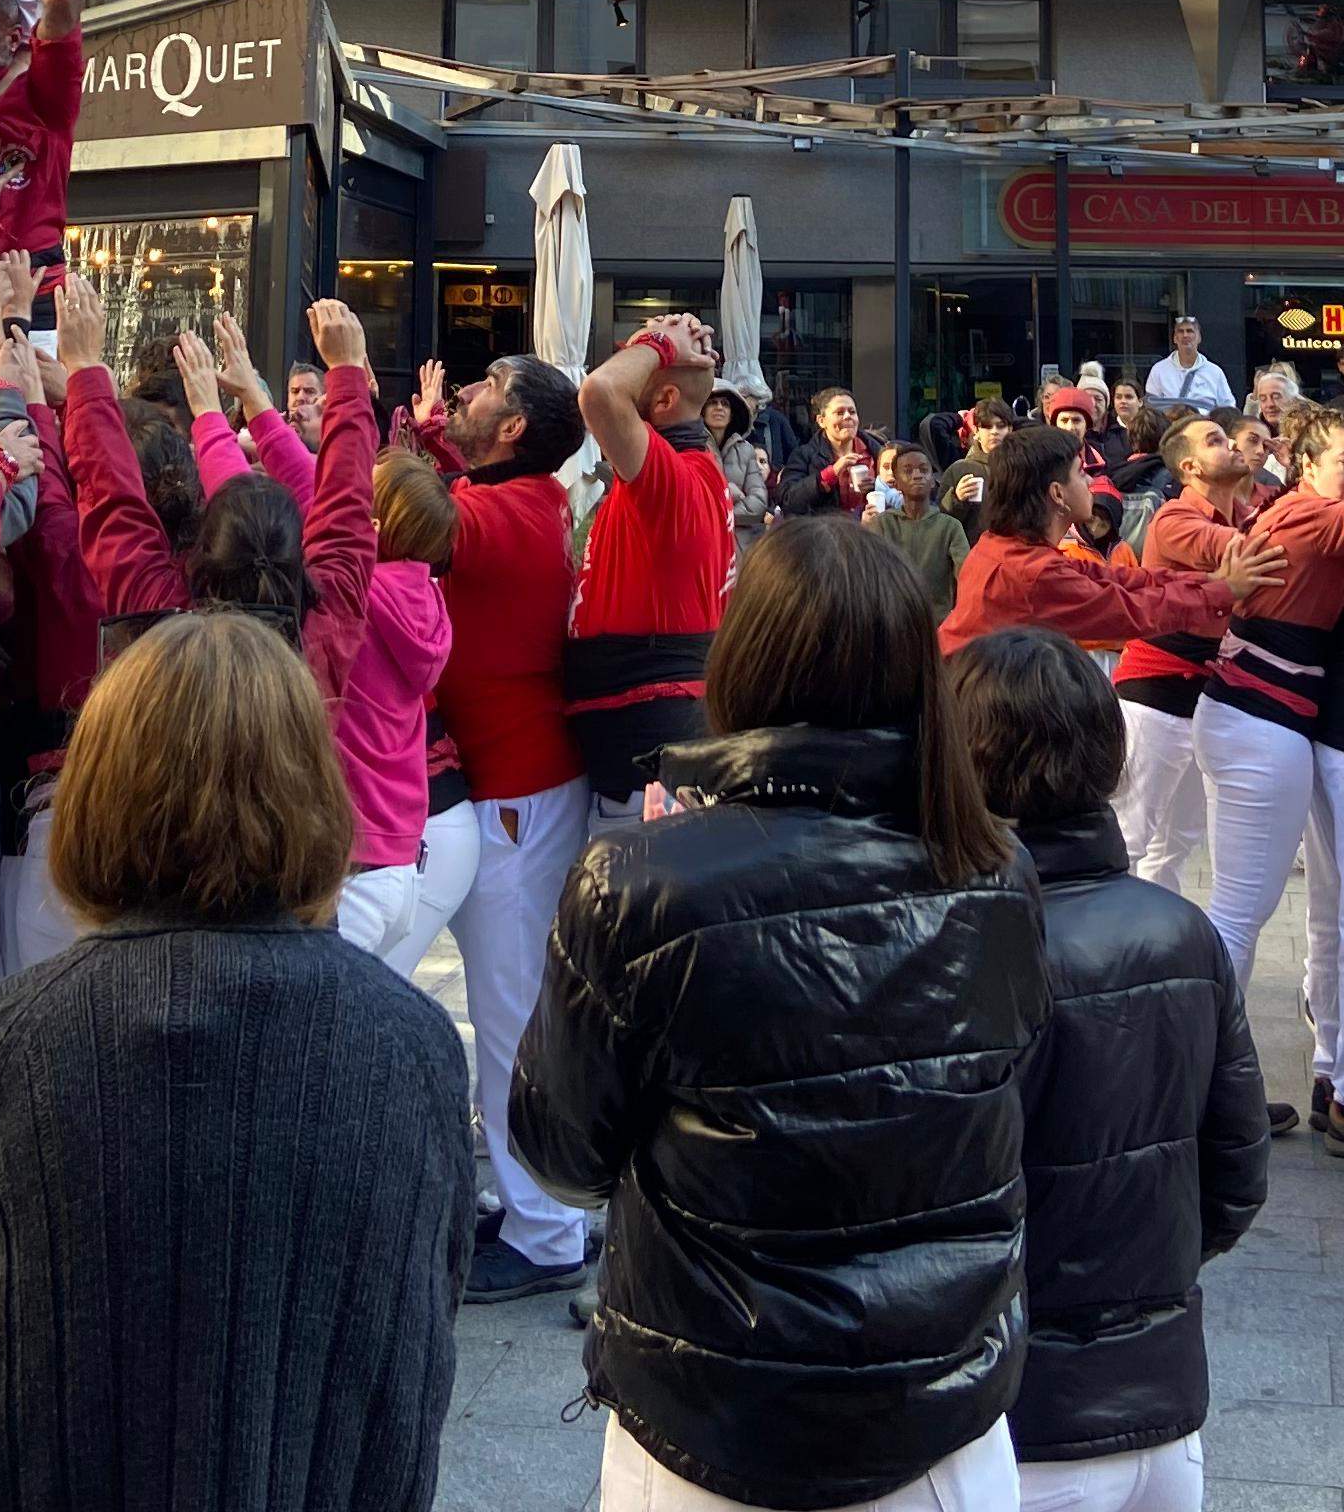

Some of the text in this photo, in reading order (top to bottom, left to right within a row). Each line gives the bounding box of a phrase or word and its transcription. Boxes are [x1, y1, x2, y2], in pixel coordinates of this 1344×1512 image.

[1030, 198, 1064, 221] L
[1083, 194, 1175, 223] CASA
[1190, 200, 1250, 224] DEL
[1282, 336, 1342, 350] Únicos
